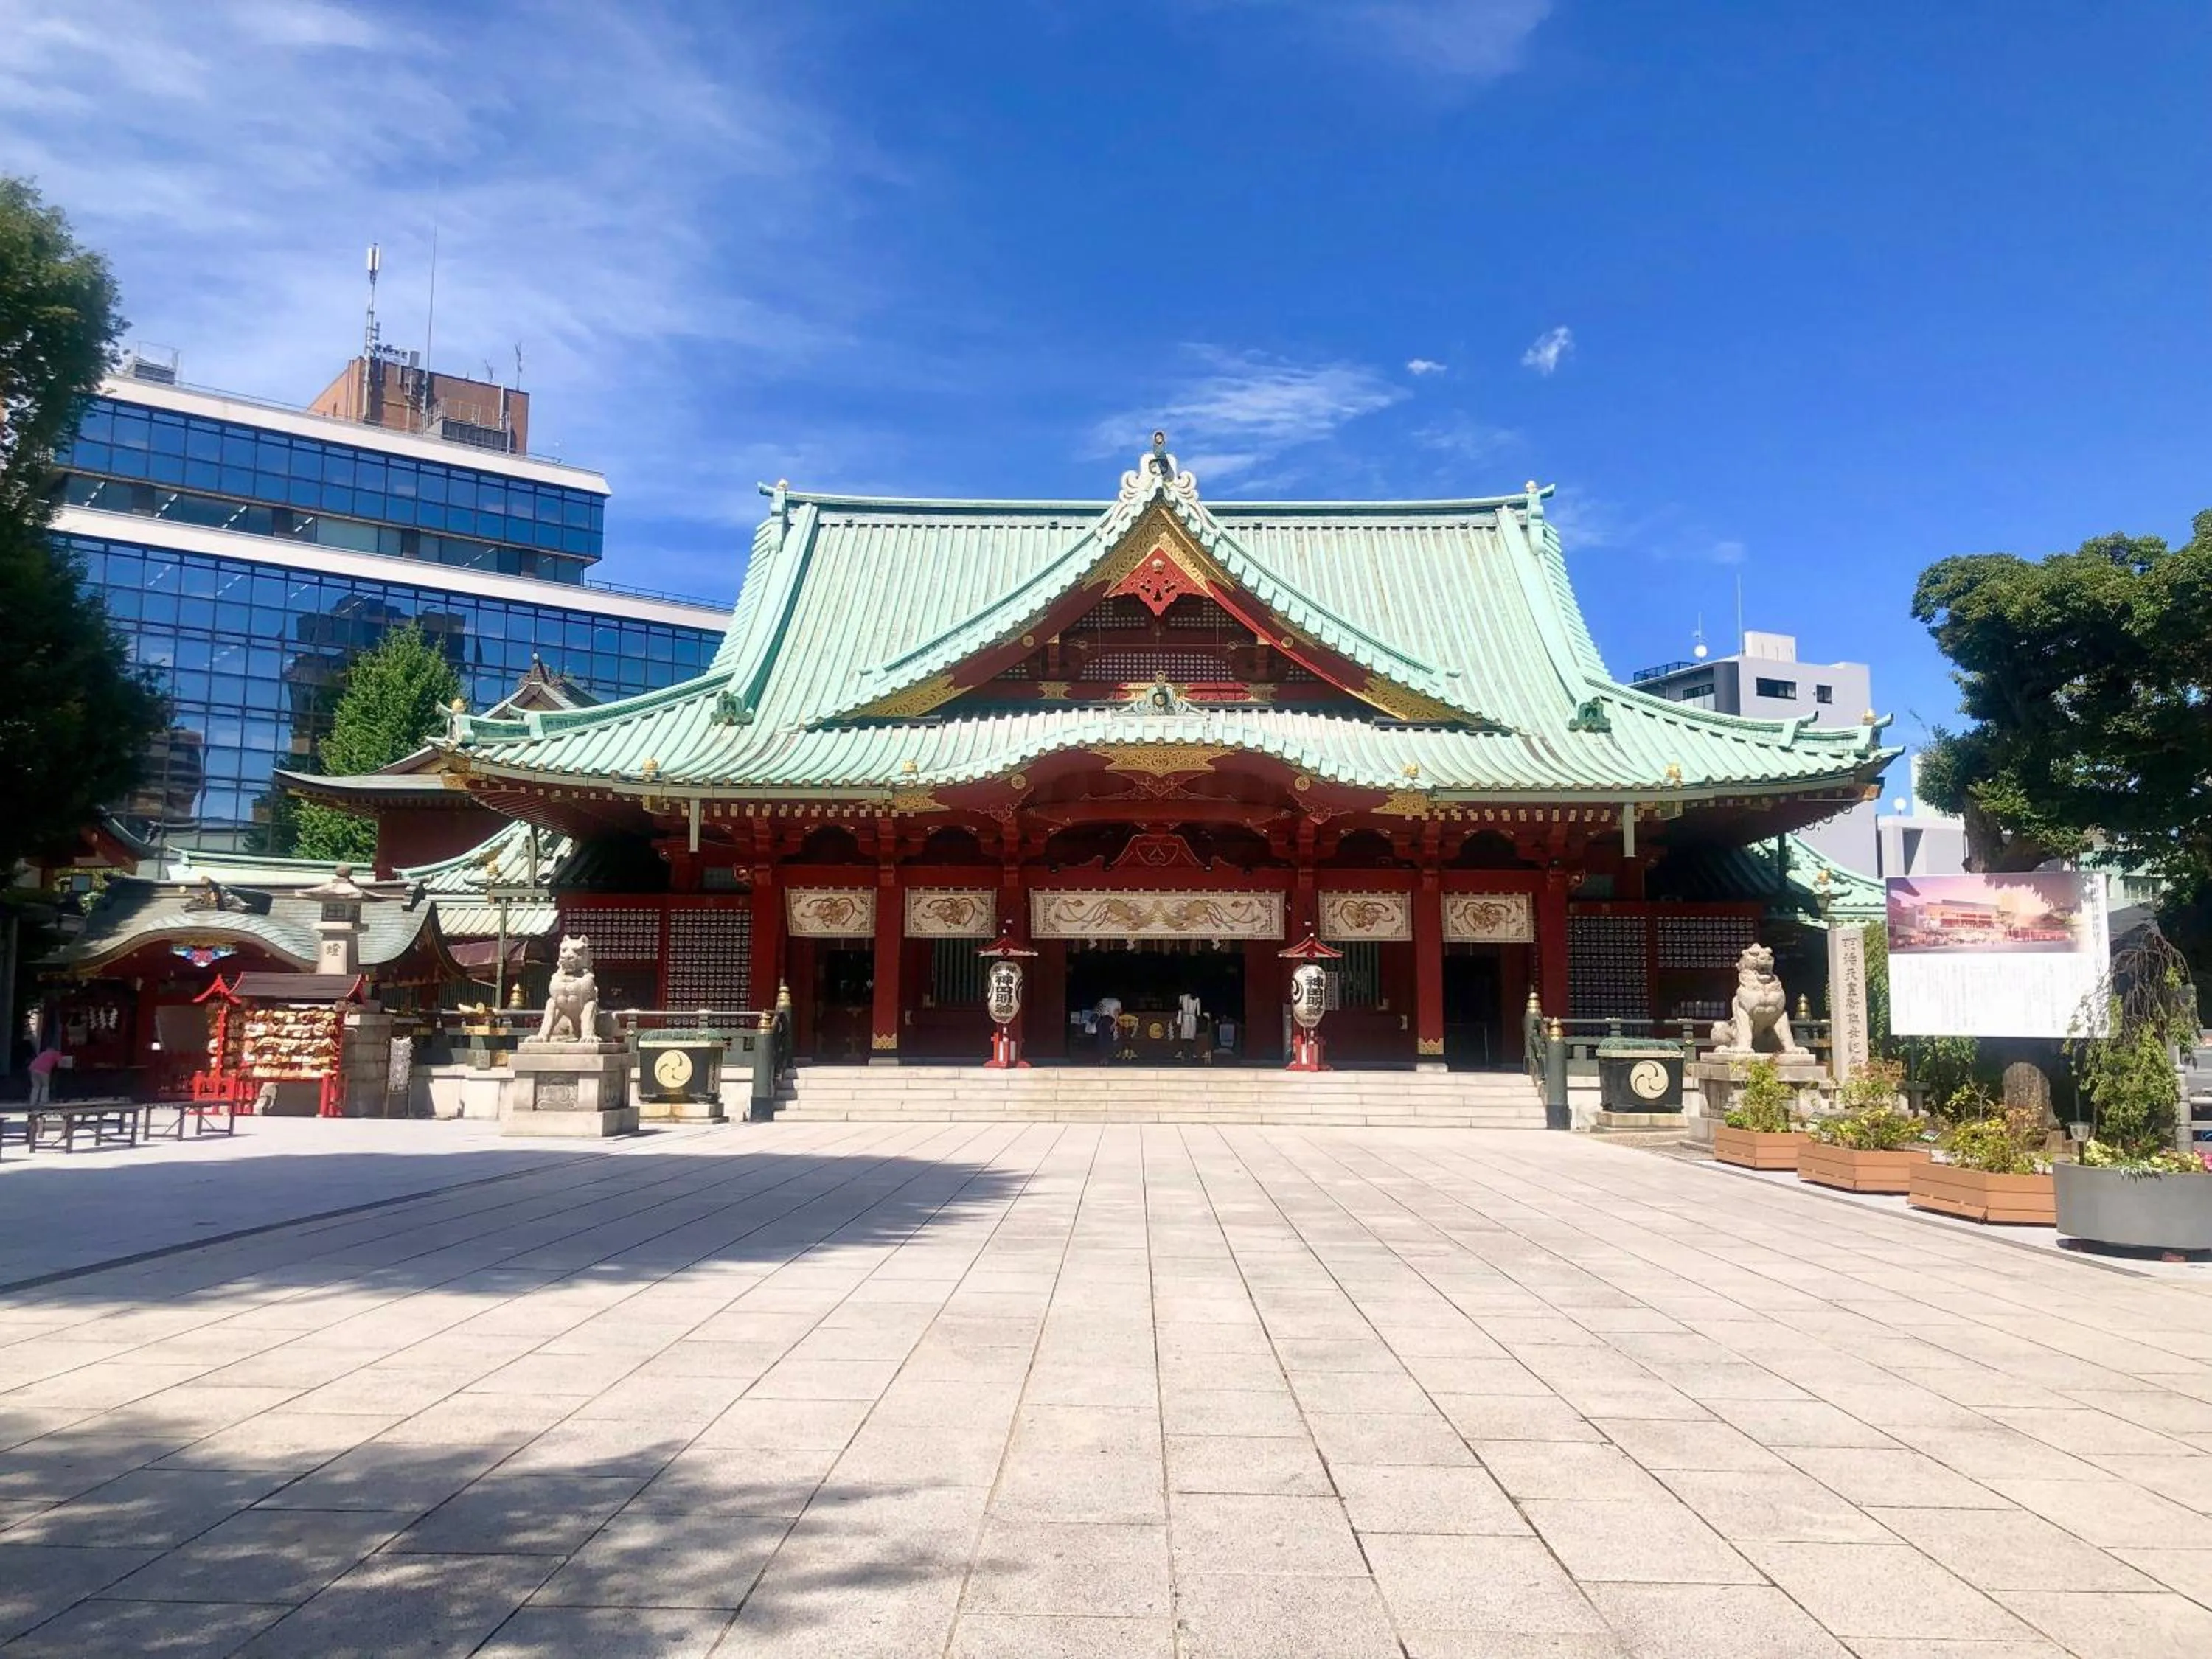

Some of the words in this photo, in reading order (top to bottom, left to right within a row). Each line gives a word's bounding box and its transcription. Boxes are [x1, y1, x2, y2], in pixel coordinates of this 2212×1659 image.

[995, 973, 1014, 1014] 神田明神
[1305, 975, 1324, 1016] 神田明神
